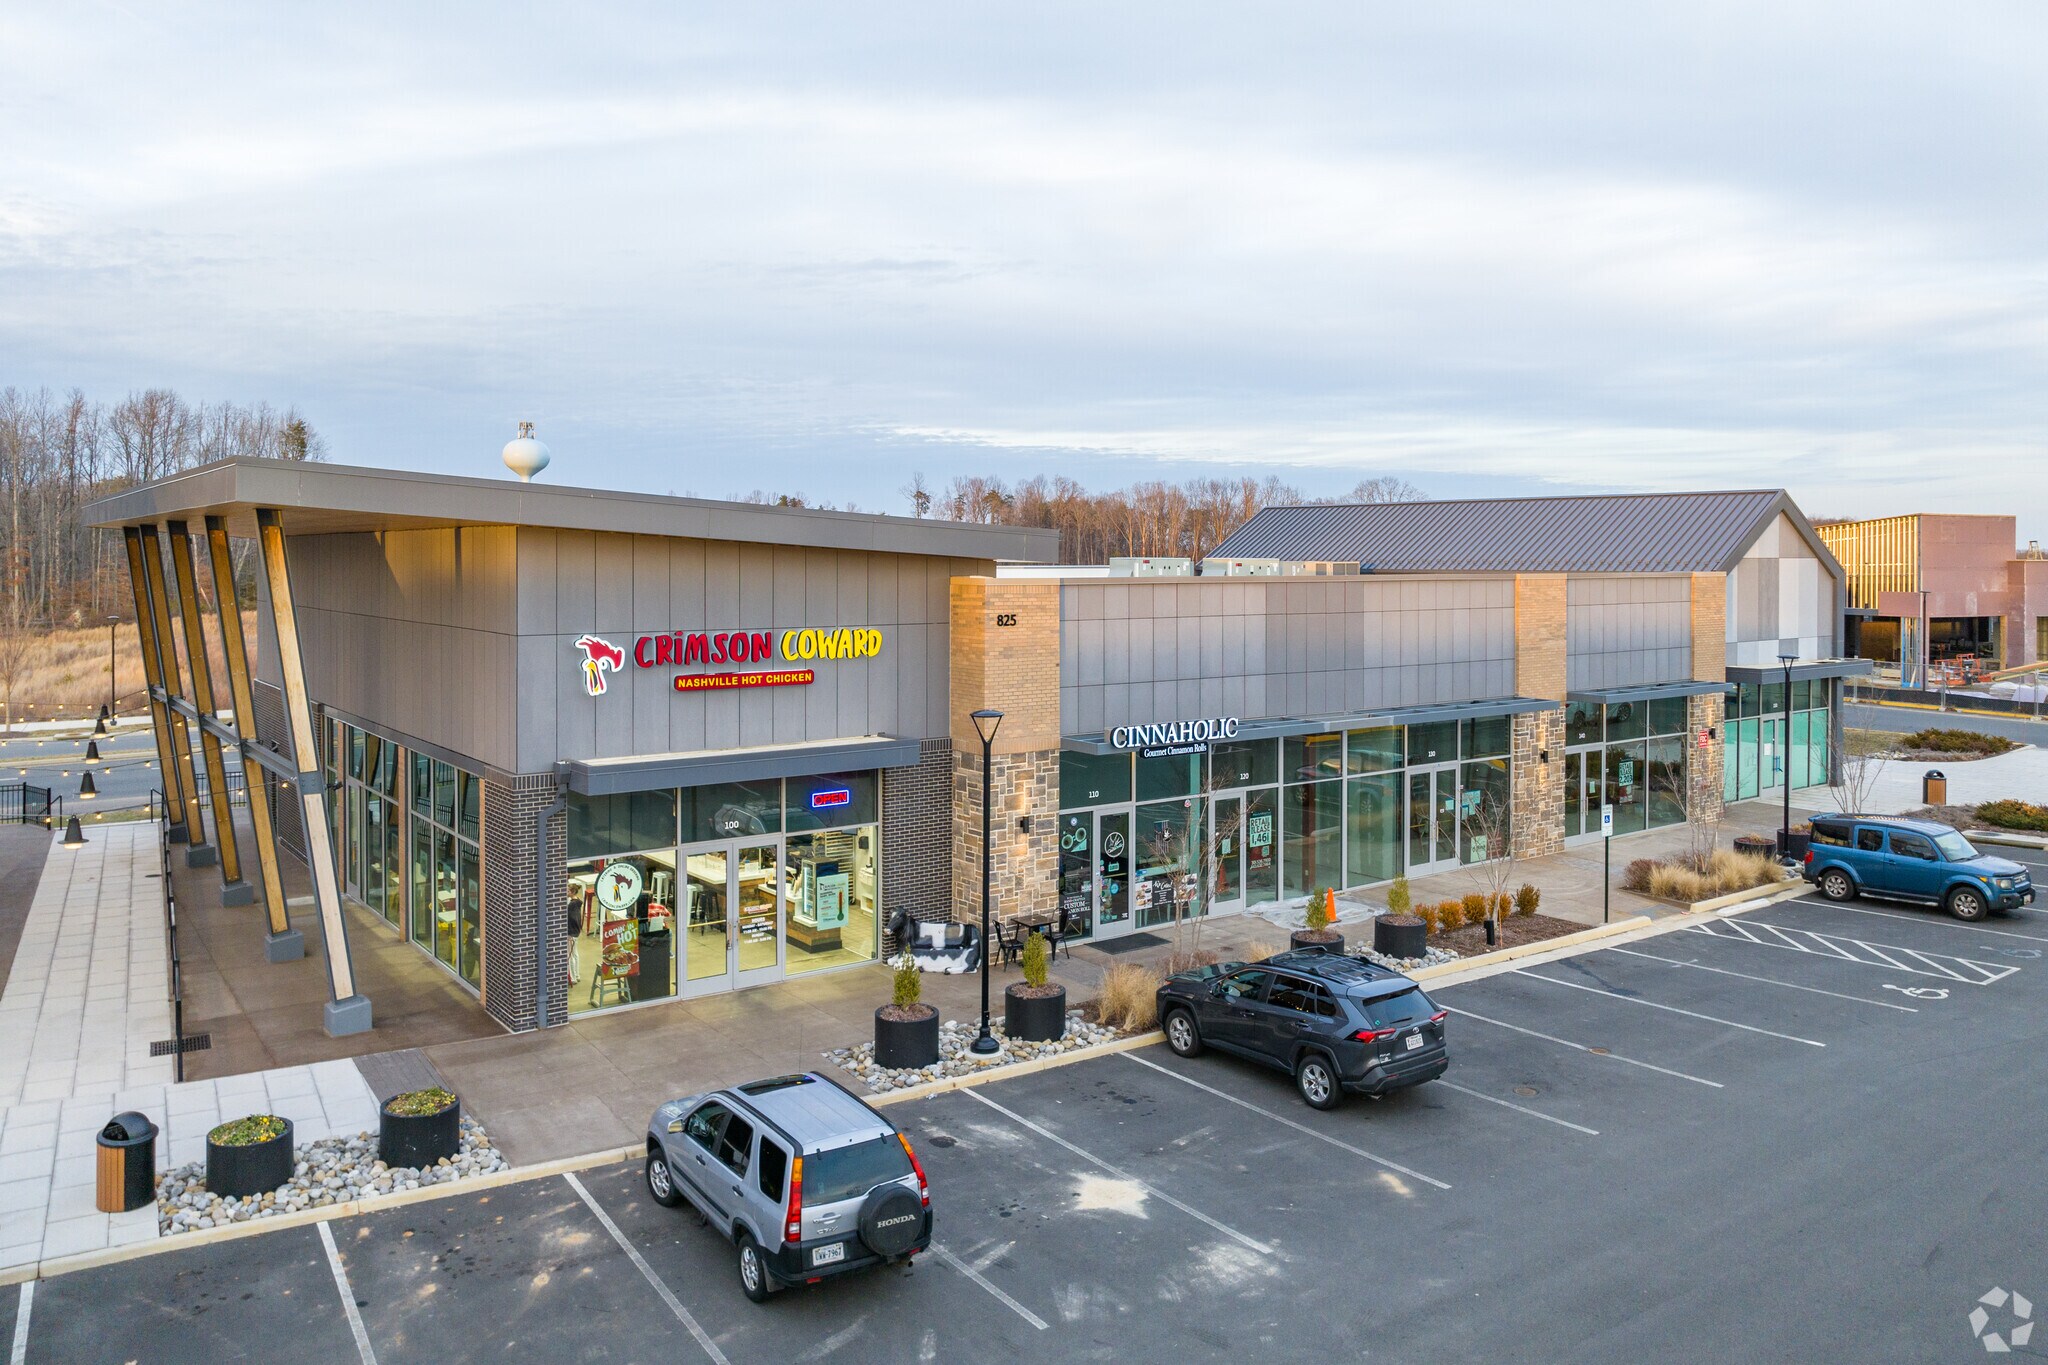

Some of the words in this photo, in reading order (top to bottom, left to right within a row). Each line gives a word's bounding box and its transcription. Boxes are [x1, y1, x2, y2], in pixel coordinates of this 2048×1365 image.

[997, 614, 1017, 627] 825
[634, 630, 772, 668] CRIMSON
[780, 628, 883, 661] COWARD
[678, 675, 738, 688] NASHVILLE
[741, 674, 763, 685] HOT
[766, 672, 812, 684] CHICKEN
[1111, 717, 1239, 749] CINNAHOLIC
[1144, 748, 1167, 758] Gourmet
[1167, 746, 1194, 756] Cinnamon
[1194, 743, 1207, 753] Rolls
[813, 792, 847, 805] OPEN
[1088, 790, 1099, 799] 110
[724, 820, 739, 830] 100
[1063, 900, 1086, 910] CUSTOM
[616, 927, 638, 945] HOT
[877, 1214, 916, 1229] HONDA
